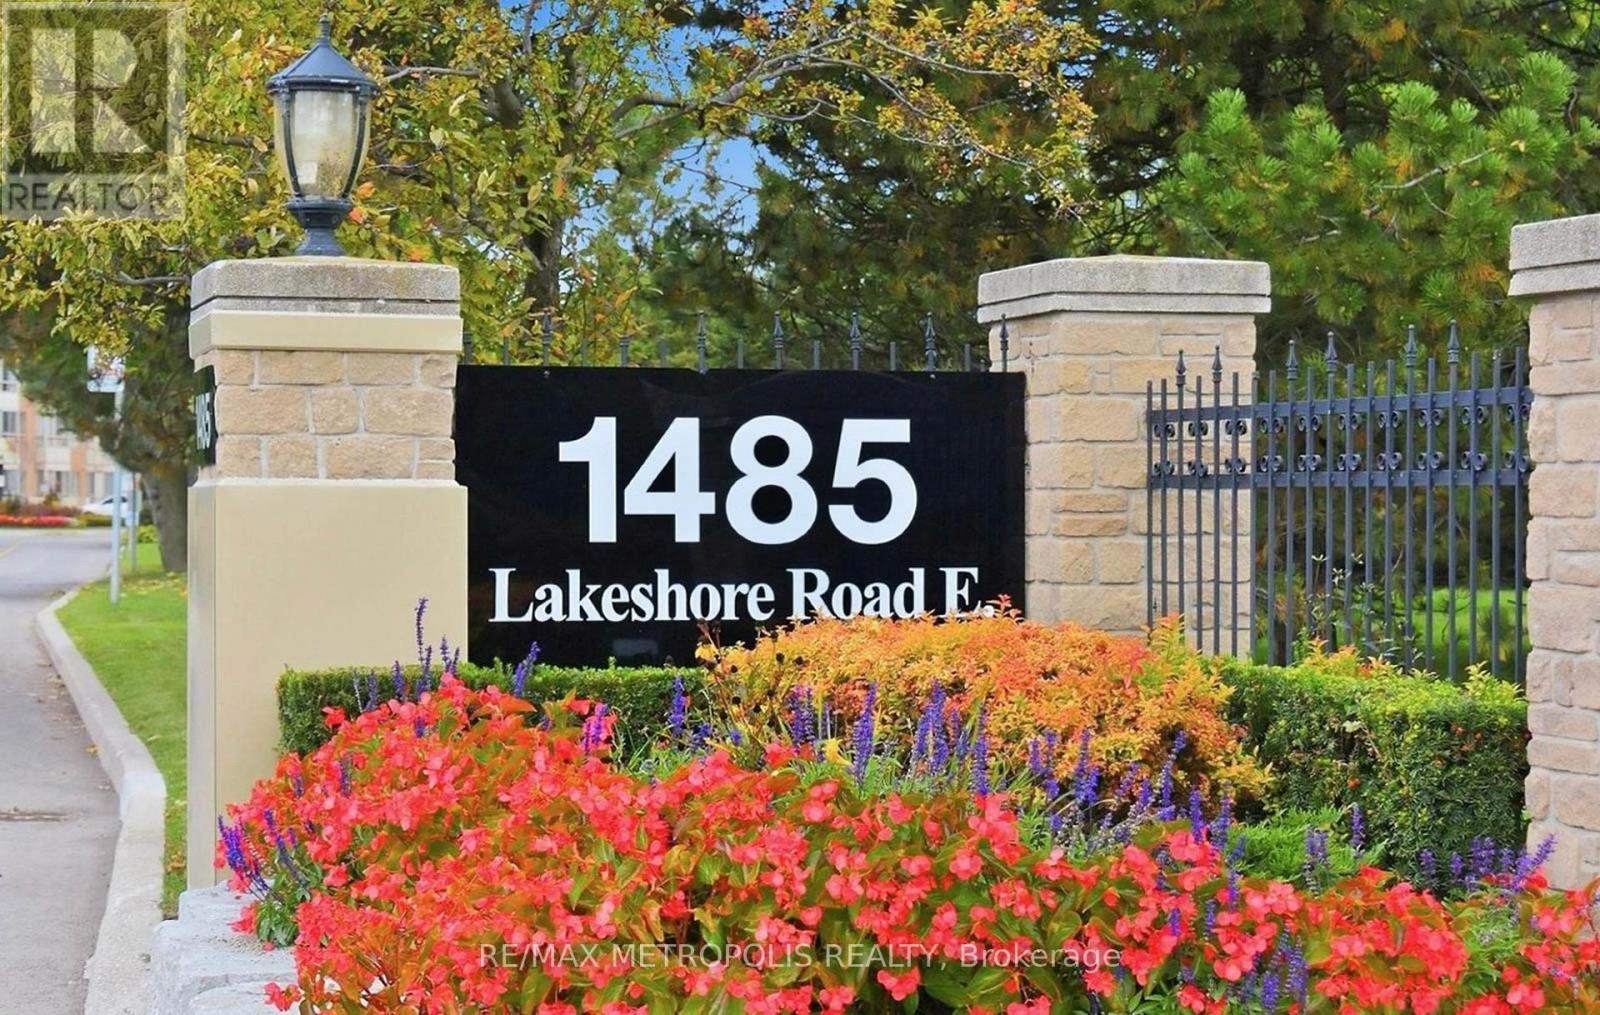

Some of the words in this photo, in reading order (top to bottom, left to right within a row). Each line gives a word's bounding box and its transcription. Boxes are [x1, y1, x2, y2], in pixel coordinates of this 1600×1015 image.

[558, 415, 918, 545] 1485
[488, 567, 776, 623] Lakeshore
[786, 567, 926, 621] Road
[938, 566, 995, 619] E.
